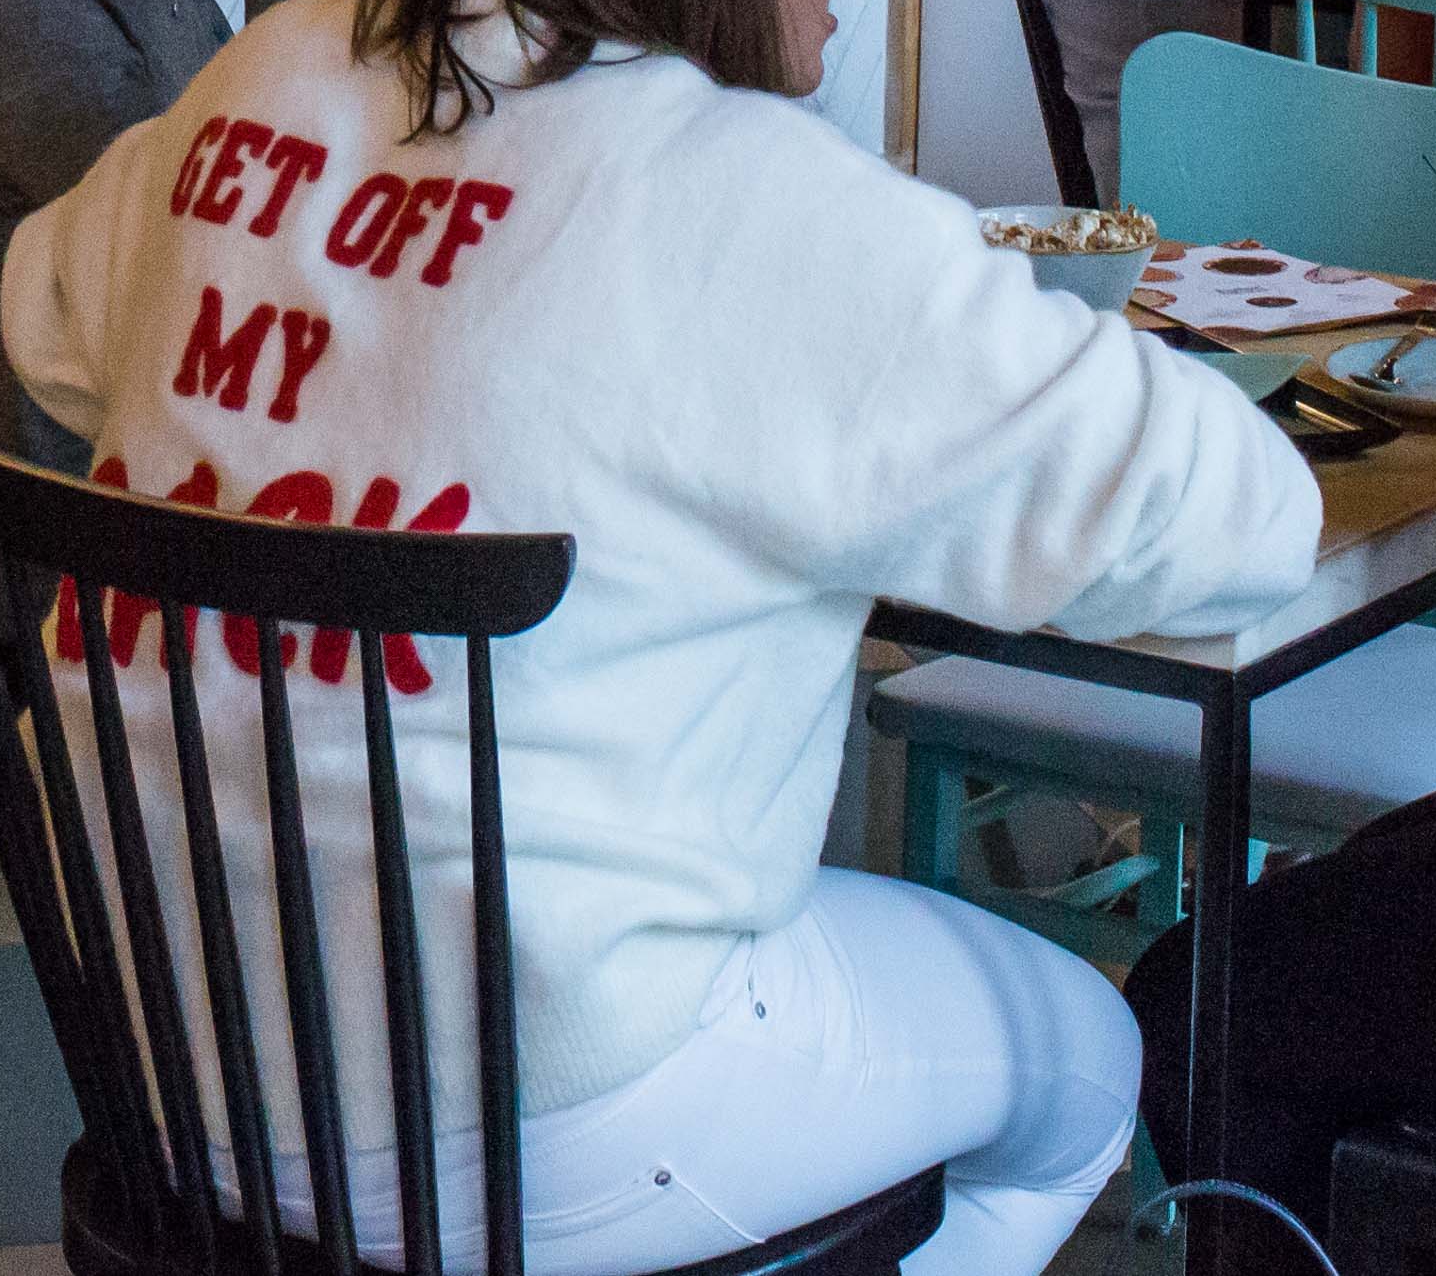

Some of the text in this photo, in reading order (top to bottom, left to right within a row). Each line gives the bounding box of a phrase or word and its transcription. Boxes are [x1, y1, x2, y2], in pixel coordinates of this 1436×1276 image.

[169, 115, 328, 239] GET
[325, 171, 515, 289] OFF
[172, 285, 332, 424] MY
